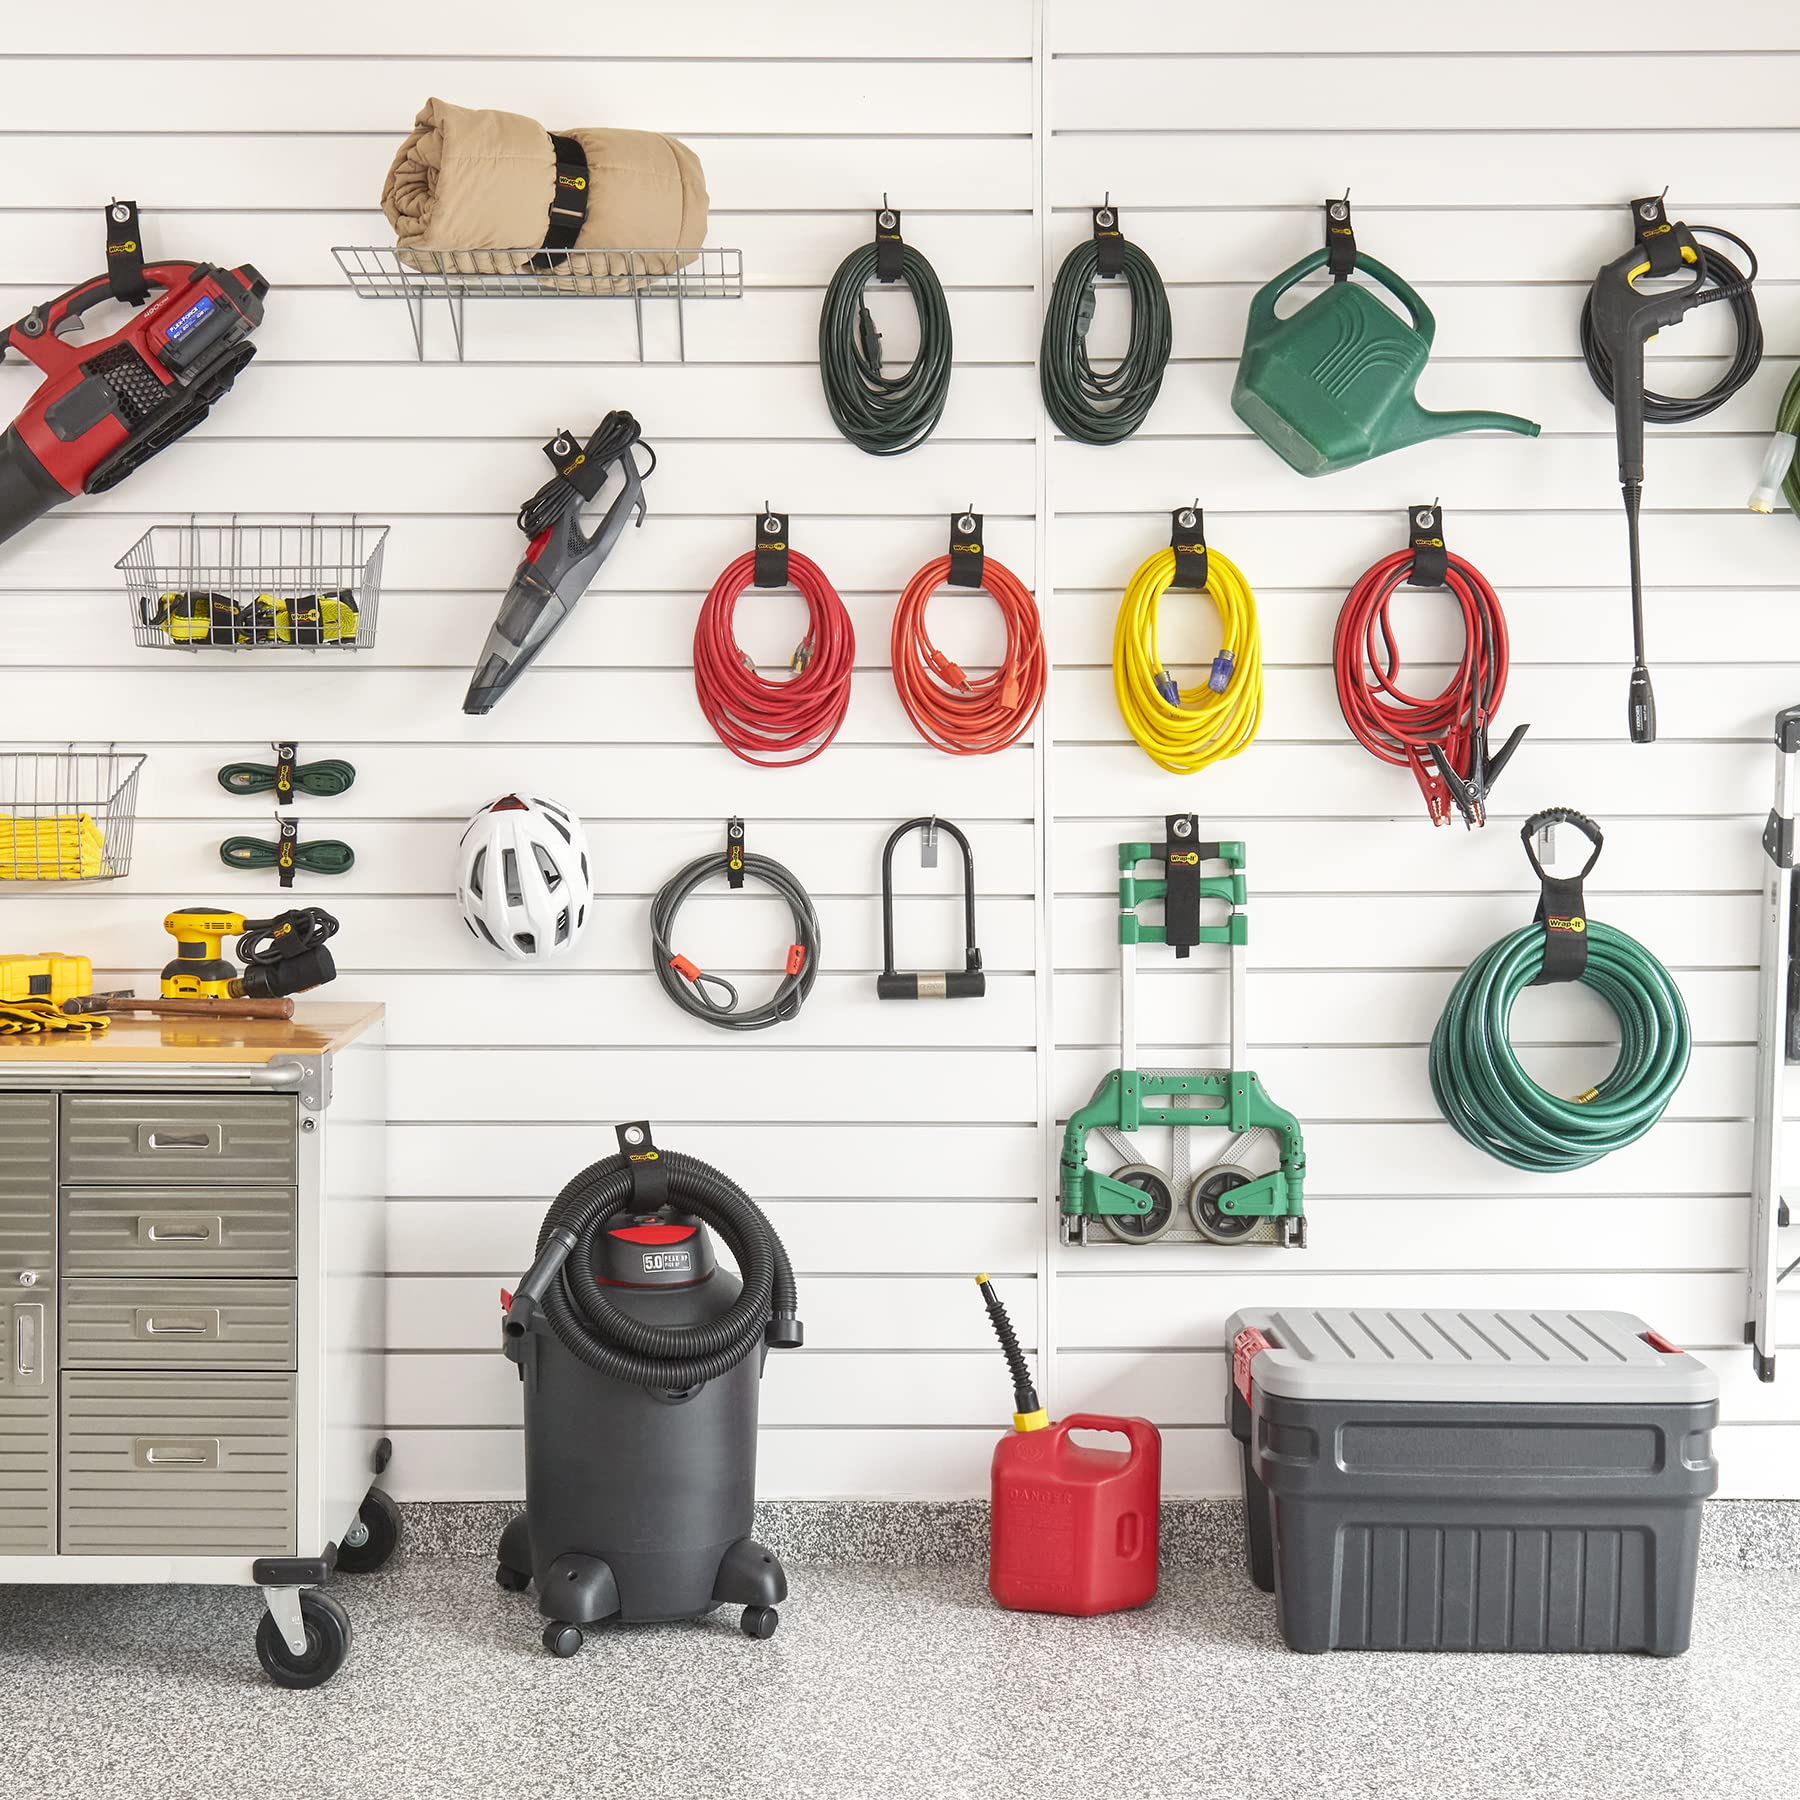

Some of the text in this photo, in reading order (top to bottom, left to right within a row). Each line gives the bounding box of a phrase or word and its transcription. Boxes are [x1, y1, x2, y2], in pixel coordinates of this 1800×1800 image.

[1171, 854, 1196, 863] Wrap-It
[1549, 918, 1583, 930] Wrap-It
[645, 1256, 662, 1269] 5.0
